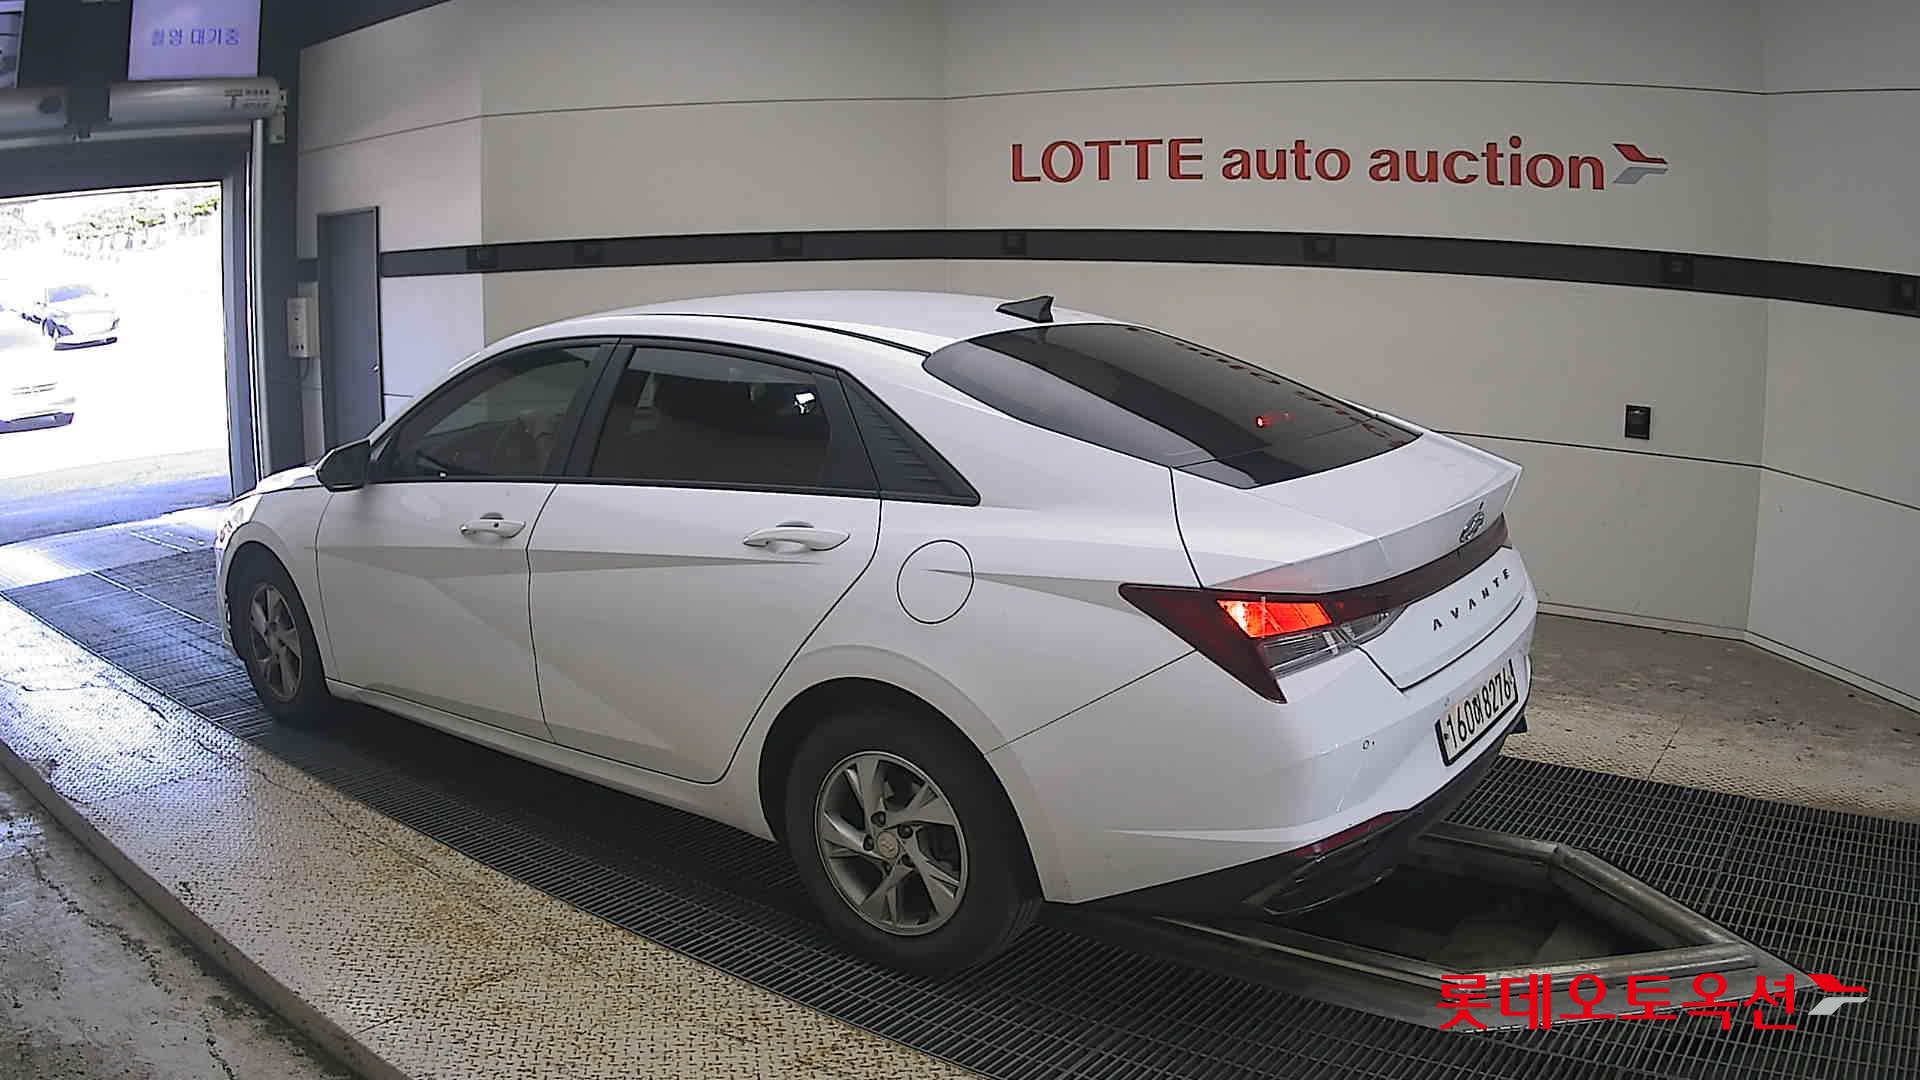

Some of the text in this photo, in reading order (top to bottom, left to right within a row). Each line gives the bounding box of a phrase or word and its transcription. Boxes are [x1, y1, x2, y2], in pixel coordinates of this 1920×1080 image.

[191, 27, 240, 46] 대기중
[1011, 136, 1605, 189] LOTTE auto auction
[1432, 568, 1511, 631] AVANTE
